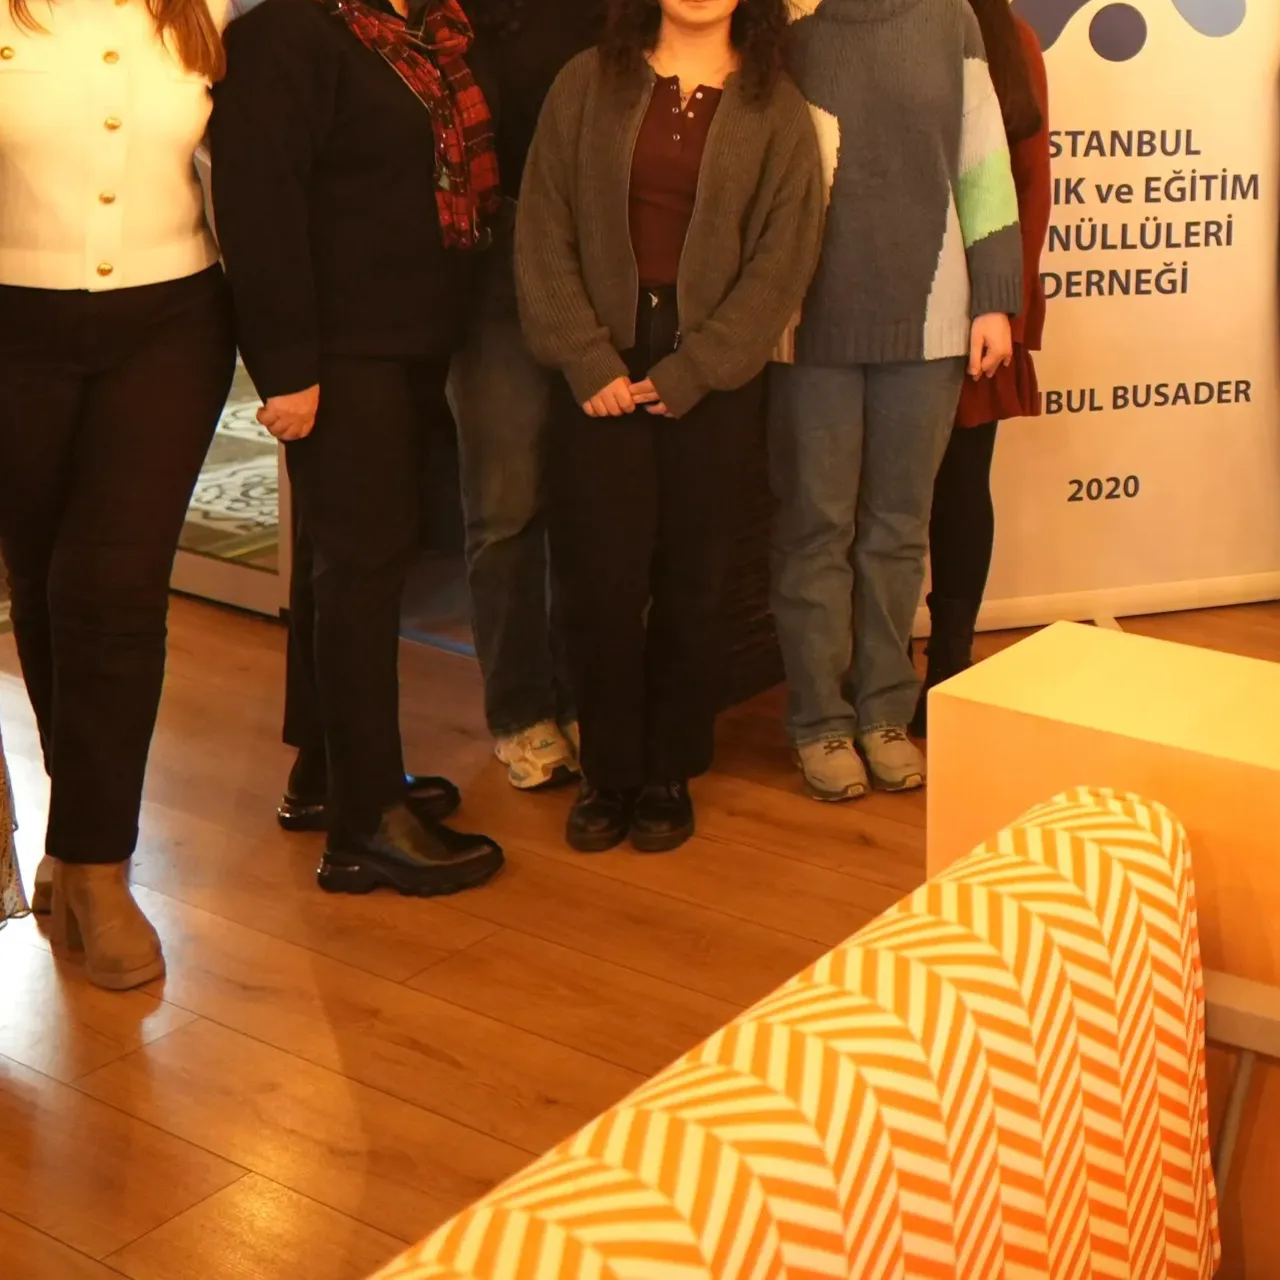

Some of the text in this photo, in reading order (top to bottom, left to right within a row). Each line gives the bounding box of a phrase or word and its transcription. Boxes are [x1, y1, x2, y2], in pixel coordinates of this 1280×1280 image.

[1048, 129, 1202, 159] STANBUL
[1095, 182, 1134, 205] ve
[1144, 167, 1259, 204] EĞİTİM
[1048, 213, 1233, 253] NÜLLÜLERİ
[1039, 260, 1189, 300] DERNEĞİ
[1039, 379, 1252, 415] BUL BUSADER
[1066, 474, 1140, 503] 2020
